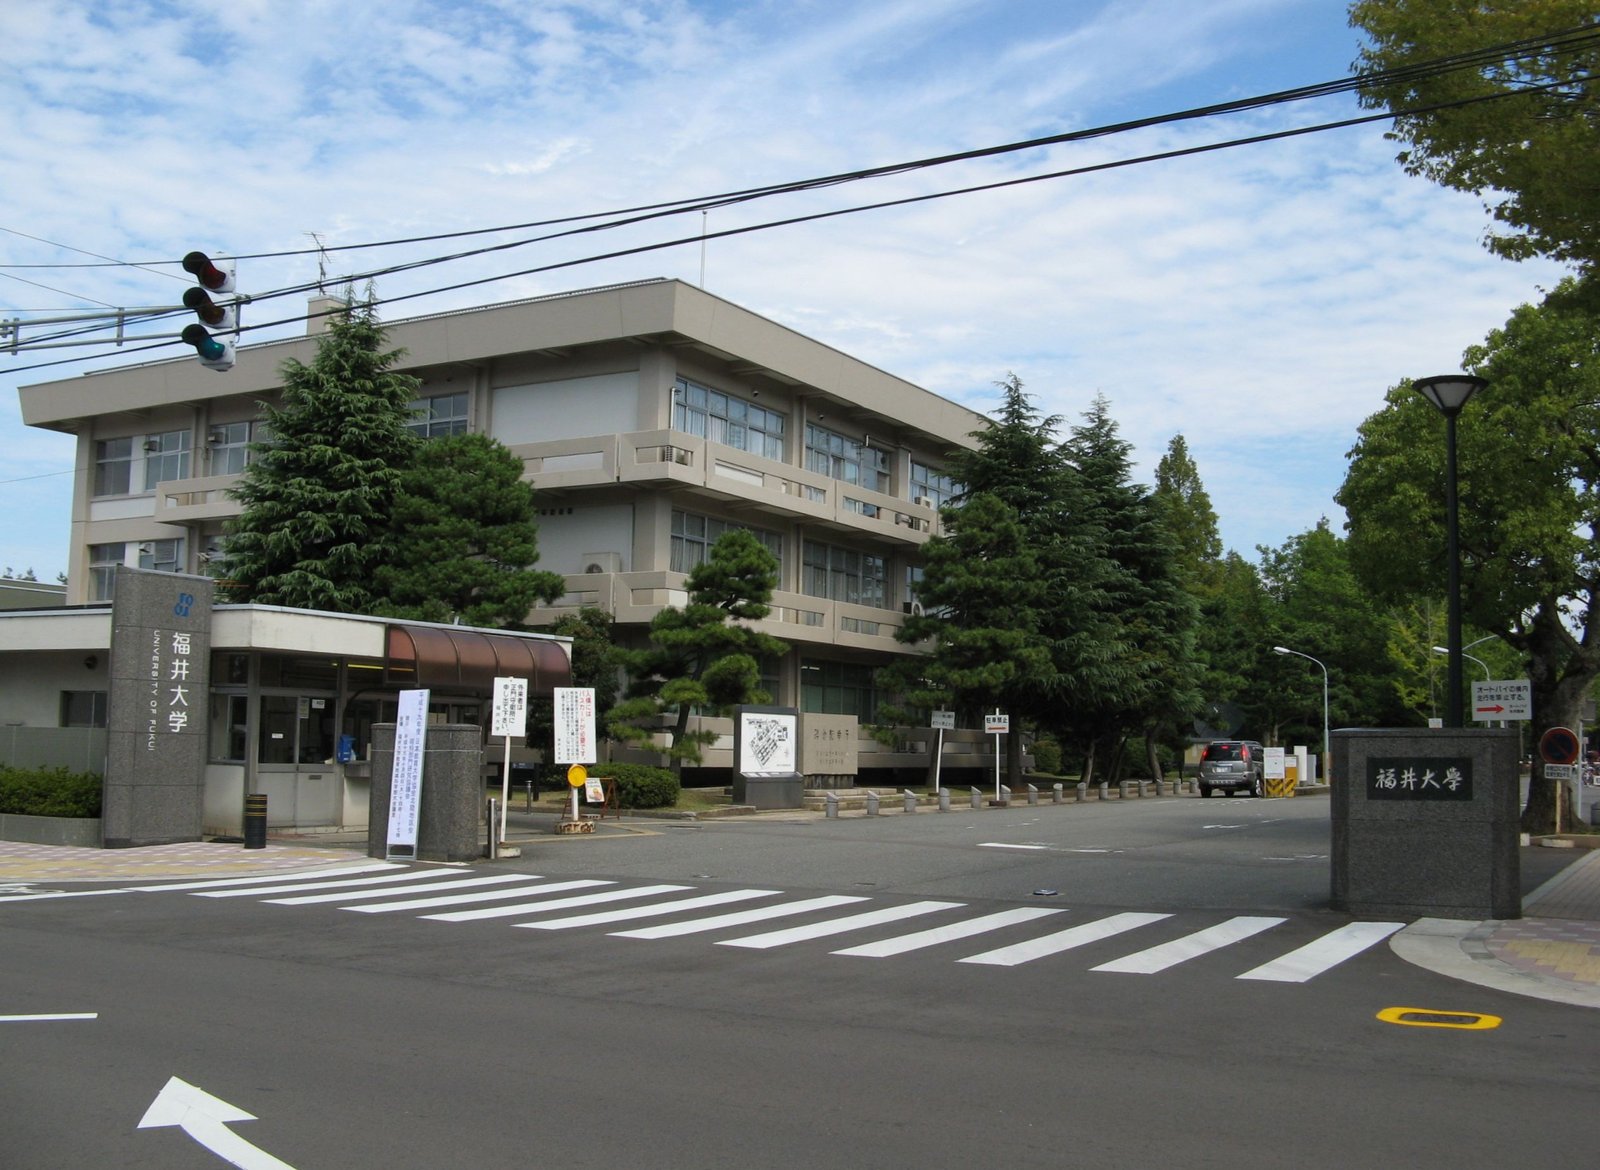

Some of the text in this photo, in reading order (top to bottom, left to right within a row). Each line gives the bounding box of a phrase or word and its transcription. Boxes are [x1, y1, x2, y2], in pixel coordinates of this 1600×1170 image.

[148, 630, 160, 751] UNIVERSITY OF FUKUI
[169, 632, 191, 733] 福井大学
[1375, 767, 1463, 791] 福井大學
